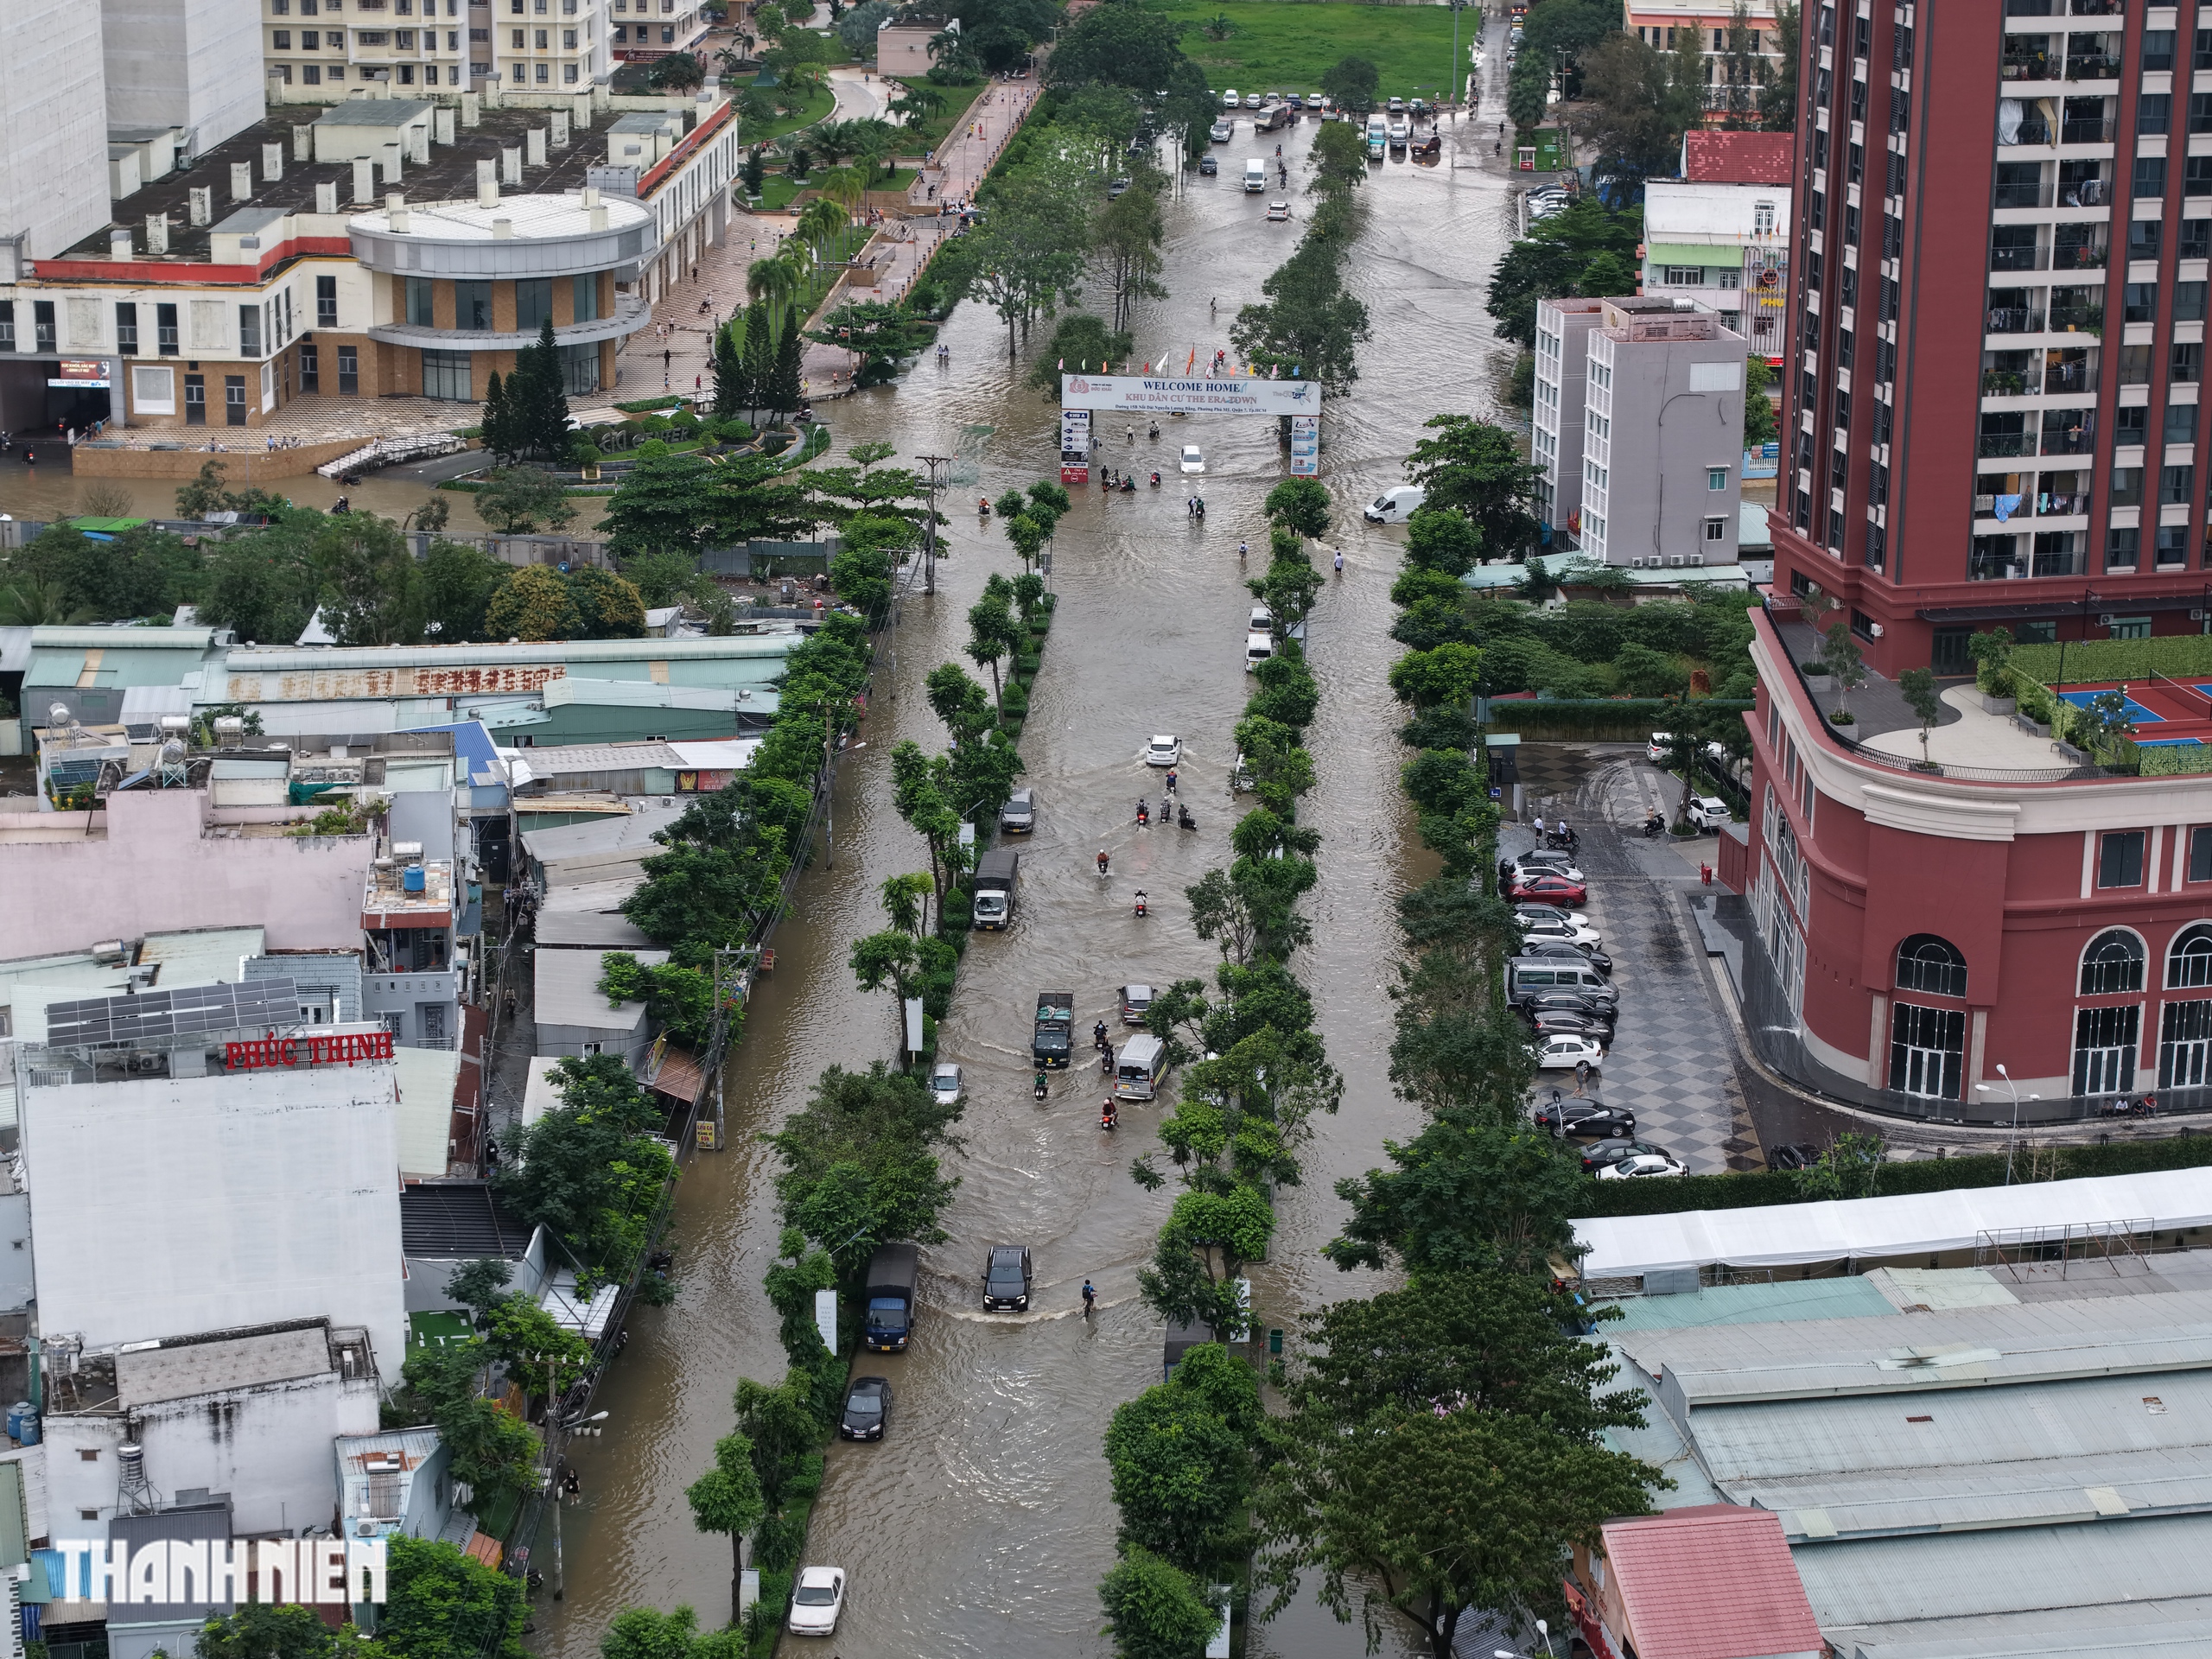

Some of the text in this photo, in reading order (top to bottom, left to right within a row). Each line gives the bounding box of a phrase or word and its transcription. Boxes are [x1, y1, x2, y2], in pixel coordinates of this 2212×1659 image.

[1761, 296, 1784, 307] PHÚ
[1143, 381, 1240, 392] WELCOME HOME
[1125, 392, 1257, 405] KHU DÂN CƯ THE ERA TOWN
[226, 1031, 394, 1070] PHÚC THỊNH
